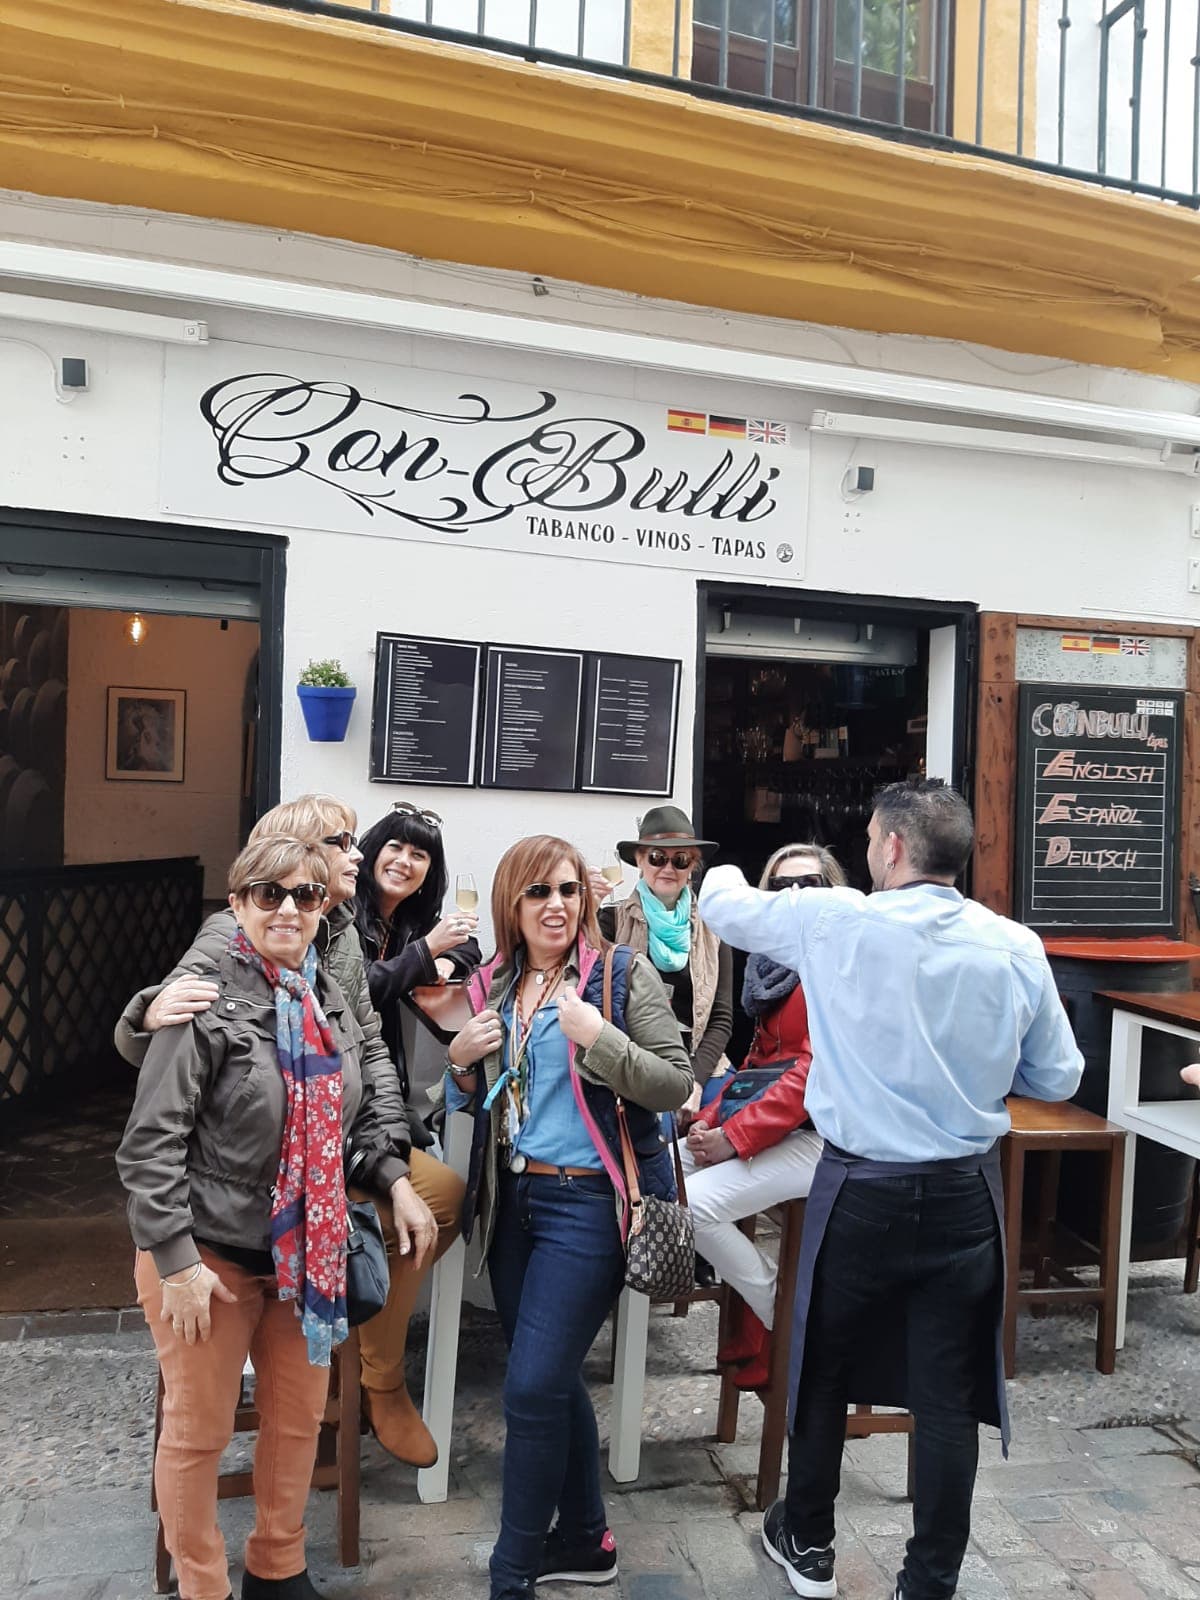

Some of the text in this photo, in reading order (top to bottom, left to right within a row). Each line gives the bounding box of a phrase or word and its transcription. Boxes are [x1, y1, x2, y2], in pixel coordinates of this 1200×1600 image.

[526, 516, 615, 544] TABANCO
[636, 528, 691, 552] VINOS
[711, 536, 767, 559] TAPAS
